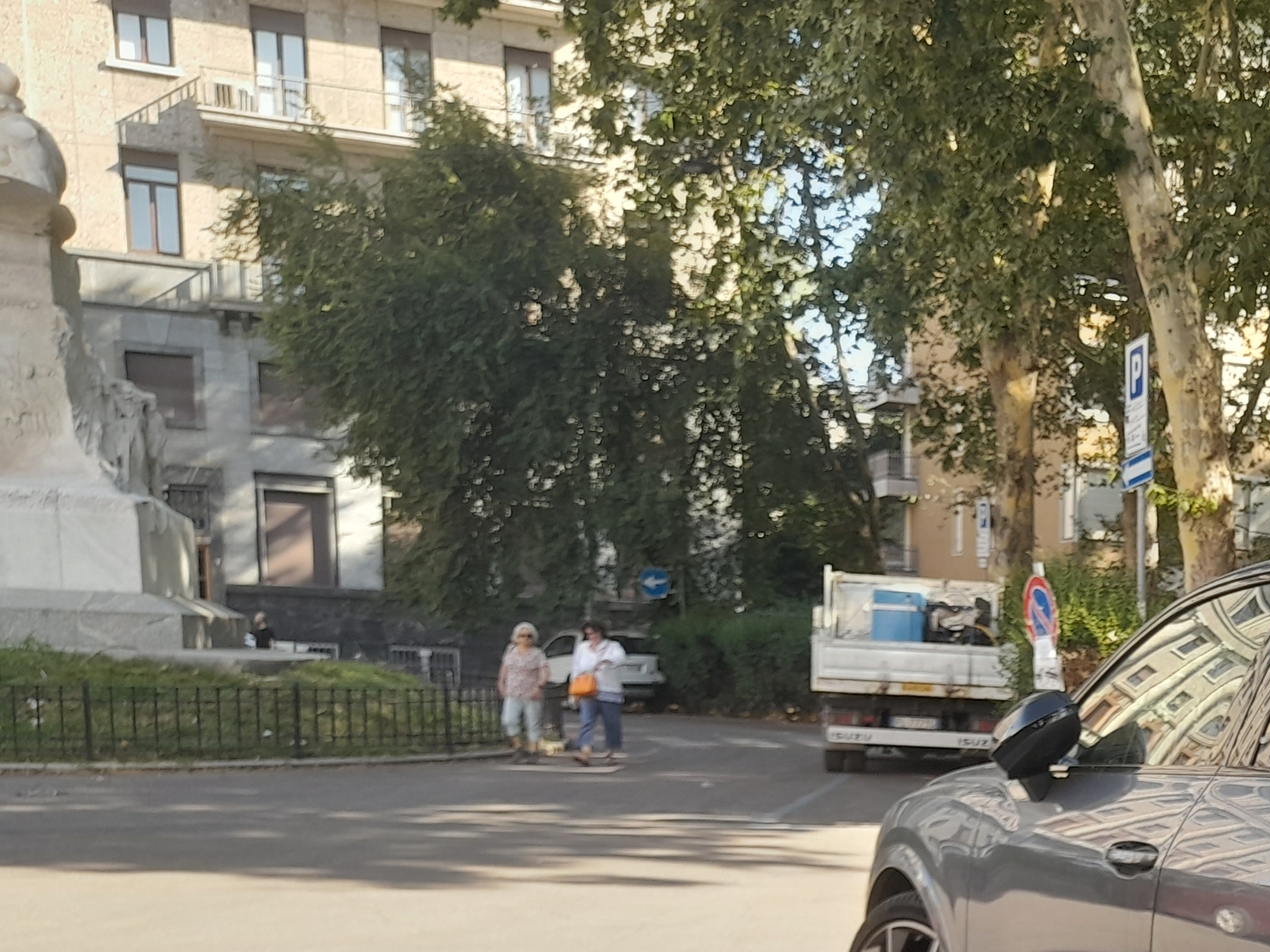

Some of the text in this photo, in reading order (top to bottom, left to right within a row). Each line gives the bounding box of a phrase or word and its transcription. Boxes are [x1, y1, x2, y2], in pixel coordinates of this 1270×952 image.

[1131, 353, 1142, 394] P
[831, 732, 873, 742] ISUZU
[958, 738, 990, 748] ISUZ
